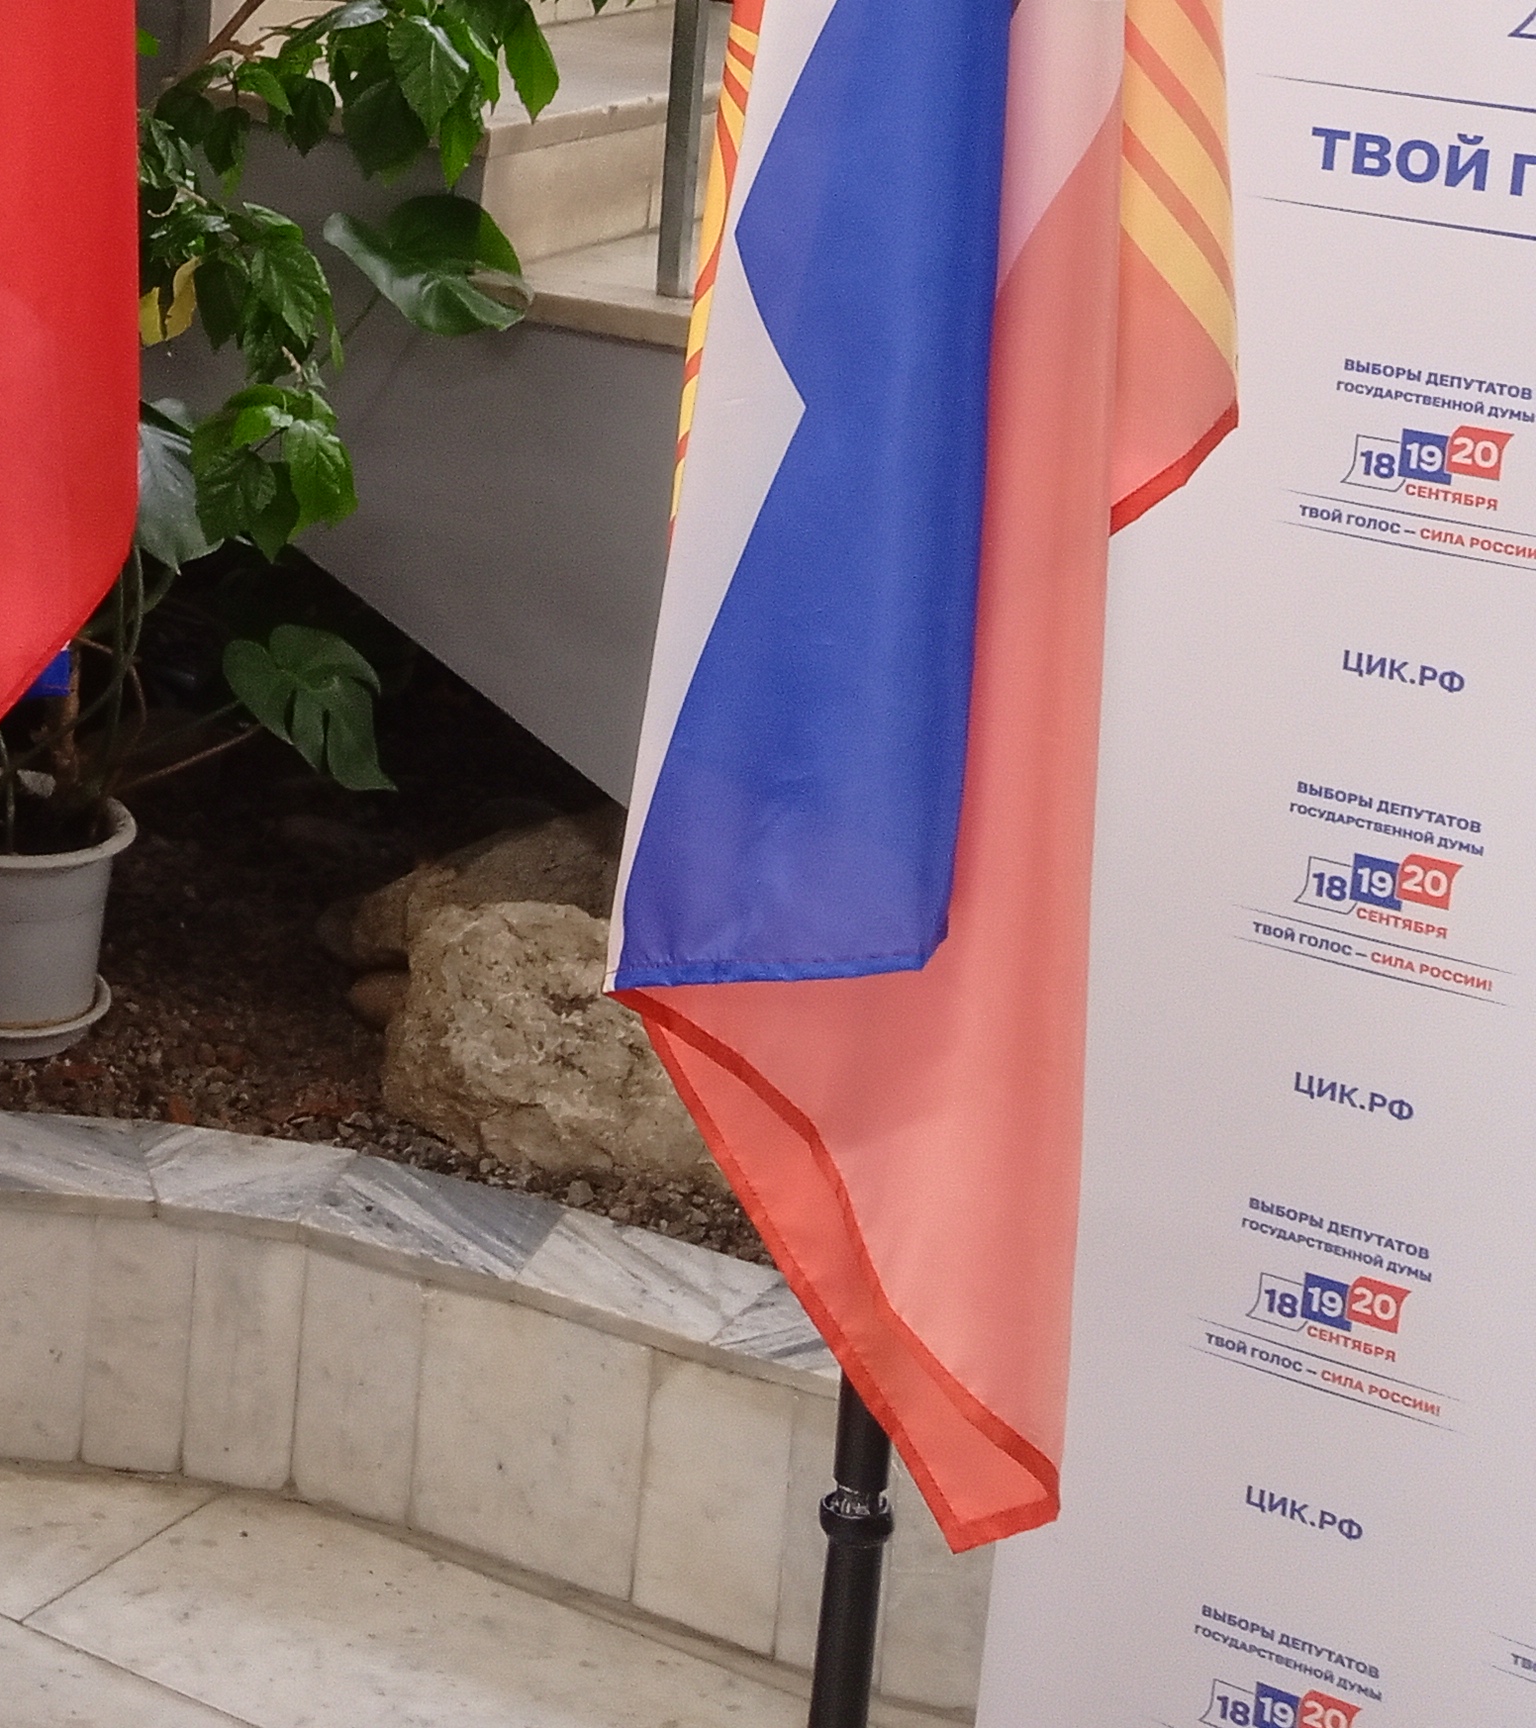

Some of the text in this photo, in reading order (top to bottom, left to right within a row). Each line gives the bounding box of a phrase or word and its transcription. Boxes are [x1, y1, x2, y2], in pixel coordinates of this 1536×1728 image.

[1311, 126, 1490, 192] ТВОЙ
[1336, 380, 1535, 423] ГОСУДАРСТВЕННОЙ ДУМЫ
[1344, 358, 1533, 401] ВЫБОРЫ ДЕПУТАТОВ
[1360, 437, 1499, 479] 18 19 20
[1405, 483, 1499, 511] СЕНТЯБРЯ
[1299, 504, 1342, 523] ТВОЙ
[1346, 514, 1401, 534] ГОЛОС
[1420, 528, 1465, 547] СИЛА
[1342, 649, 1465, 693] ЦИК.РФ
[1289, 802, 1484, 856] ГОСУДАРСТВЕННОЙ ДУМЫ
[1296, 781, 1482, 834] ВЫБОРЫ ДЕПУТАТОВ
[1312, 864, 1448, 901] 18 19 20
[1356, 907, 1448, 939] СЕНТЯБРЯ
[1253, 921, 1295, 942] ТВОЙ
[1299, 933, 1353, 956] ГОЛОС
[1371, 951, 1415, 972] СИЛА
[1419, 963, 1493, 992] РОССИИ!
[1294, 1071, 1414, 1121] ЦИК.РФ
[1241, 1217, 1432, 1283] ГОСУДАРСТВЕННОЙ ДУМЫ
[1249, 1197, 1430, 1260] ВЫБОРЫ ДЕПУТАТОВ
[1264, 1286, 1397, 1321] 18 19 20
[1307, 1325, 1397, 1363] СЕНТЯБРЯ
[1205, 1332, 1247, 1355] ТВОЙ
[1250, 1347, 1303, 1373] ГОЛОС
[1321, 1369, 1364, 1393] СИЛА
[1368, 1384, 1441, 1417] РОССИИ!
[1245, 1485, 1363, 1541] ЦИК.РФ
[1194, 1624, 1382, 1702] ГОСУДАРСТВЕННОЙ ДУМЫ
[1201, 1604, 1380, 1680] ВЫБОРЫ ДЕПУТАТОВ
[1511, 1653, 1536, 1673] ТВ
[1217, 1695, 1250, 1727] 18
[1259, 1696, 1295, 1728] 19
